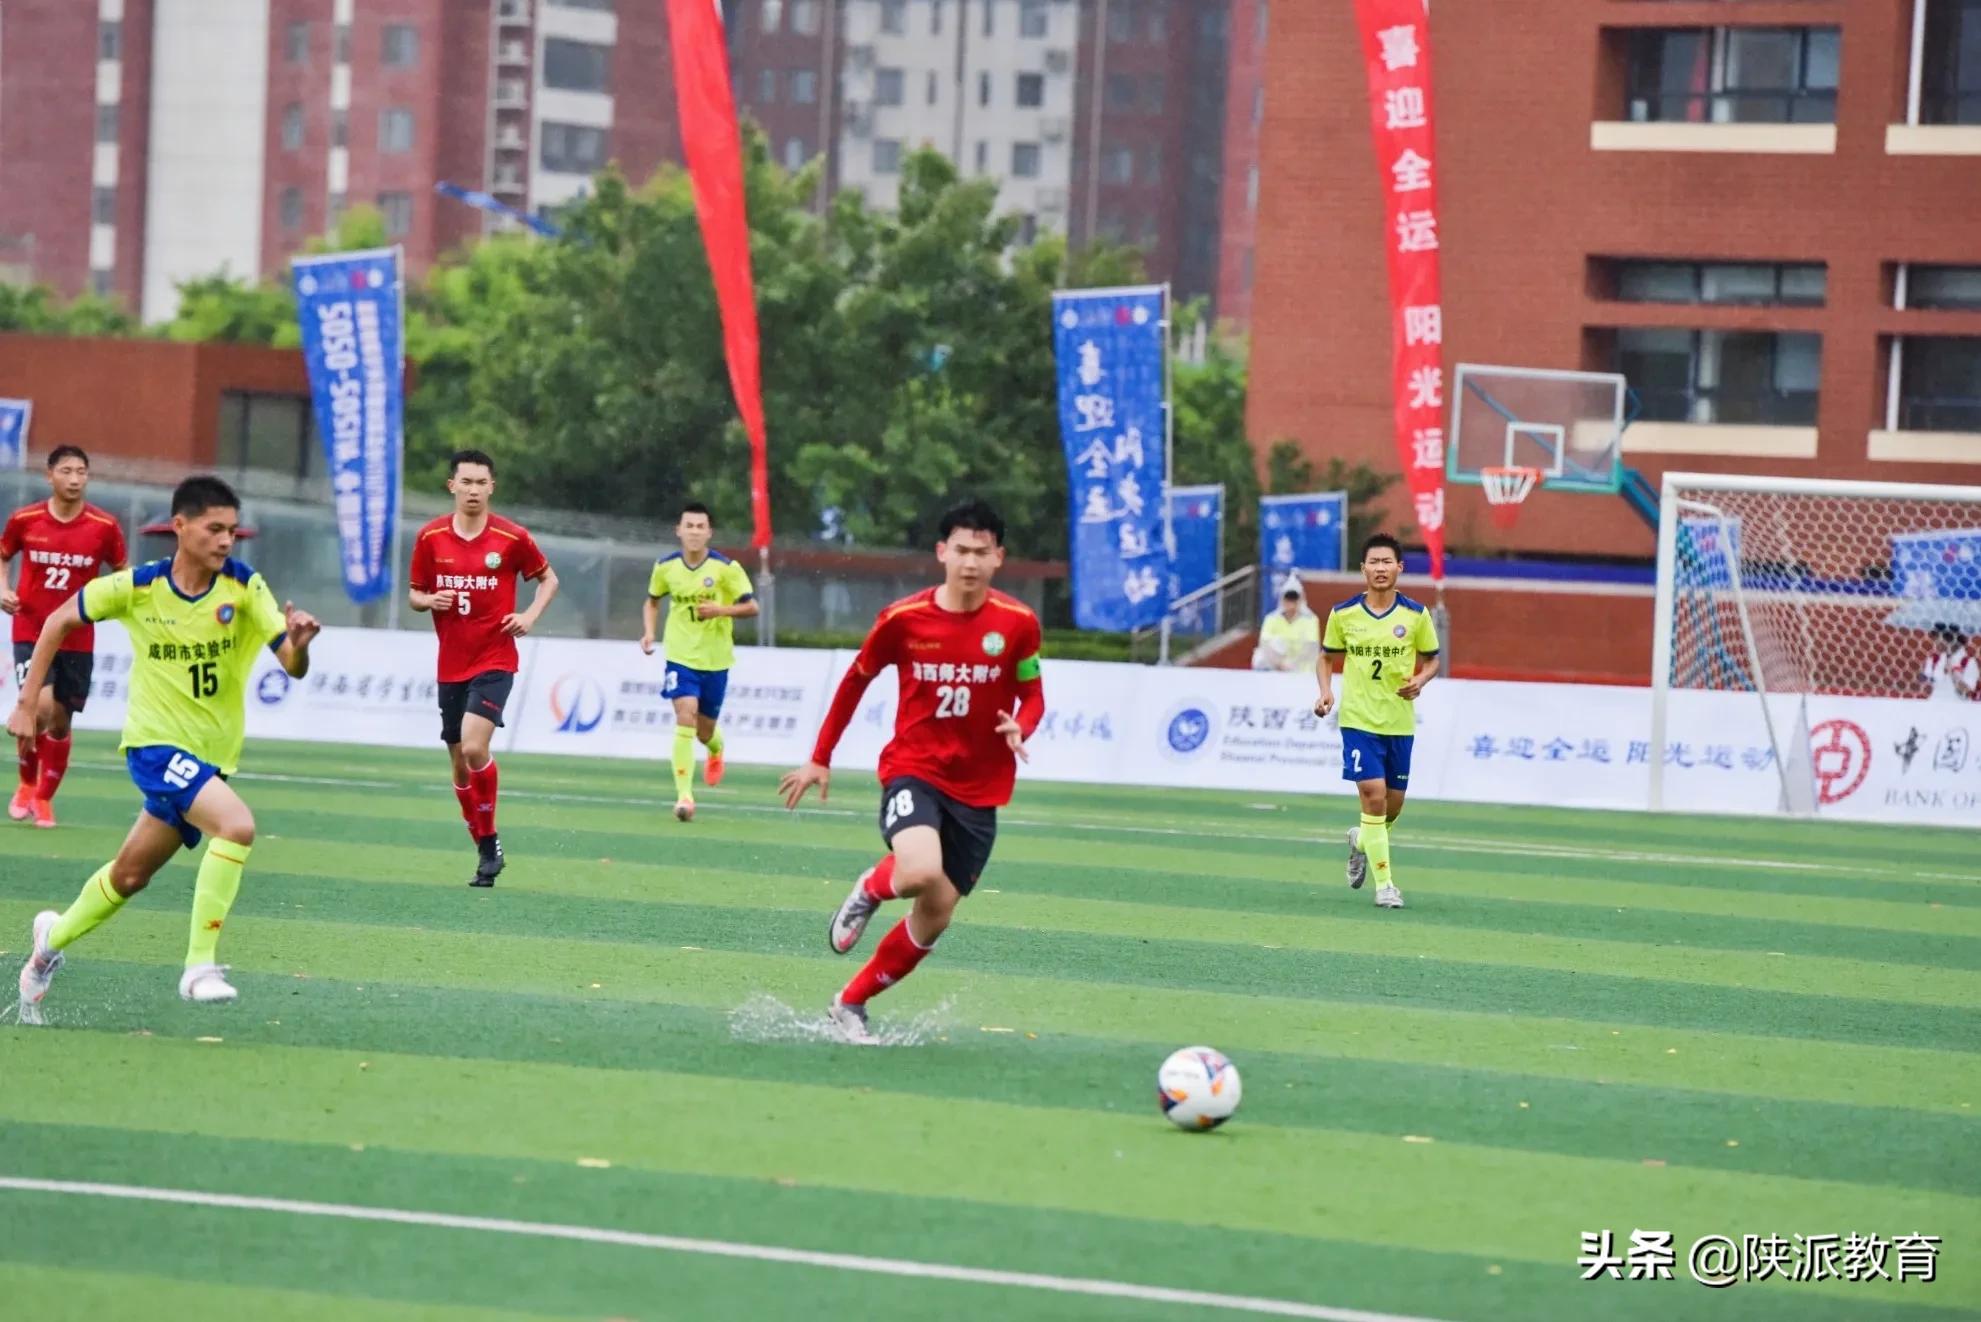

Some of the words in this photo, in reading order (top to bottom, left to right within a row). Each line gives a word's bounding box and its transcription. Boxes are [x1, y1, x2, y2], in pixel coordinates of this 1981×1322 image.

[1376, 25, 1439, 253] 喜迎全运
[1404, 304, 1444, 531] 阳光运动
[44, 567, 71, 590] 22
[457, 591, 471, 616] 5
[148, 636, 241, 660] 咸阳市实验中
[188, 662, 219, 699] 15
[1371, 659, 1383, 680] 2
[935, 685, 971, 719] 28
[1351, 749, 1362, 773] 2
[1464, 732, 1612, 765] 喜迎全运
[1894, 725, 1981, 777] 中国
[163, 752, 201, 789] 15
[885, 788, 915, 829] 28
[1885, 788, 1943, 809] BANK
